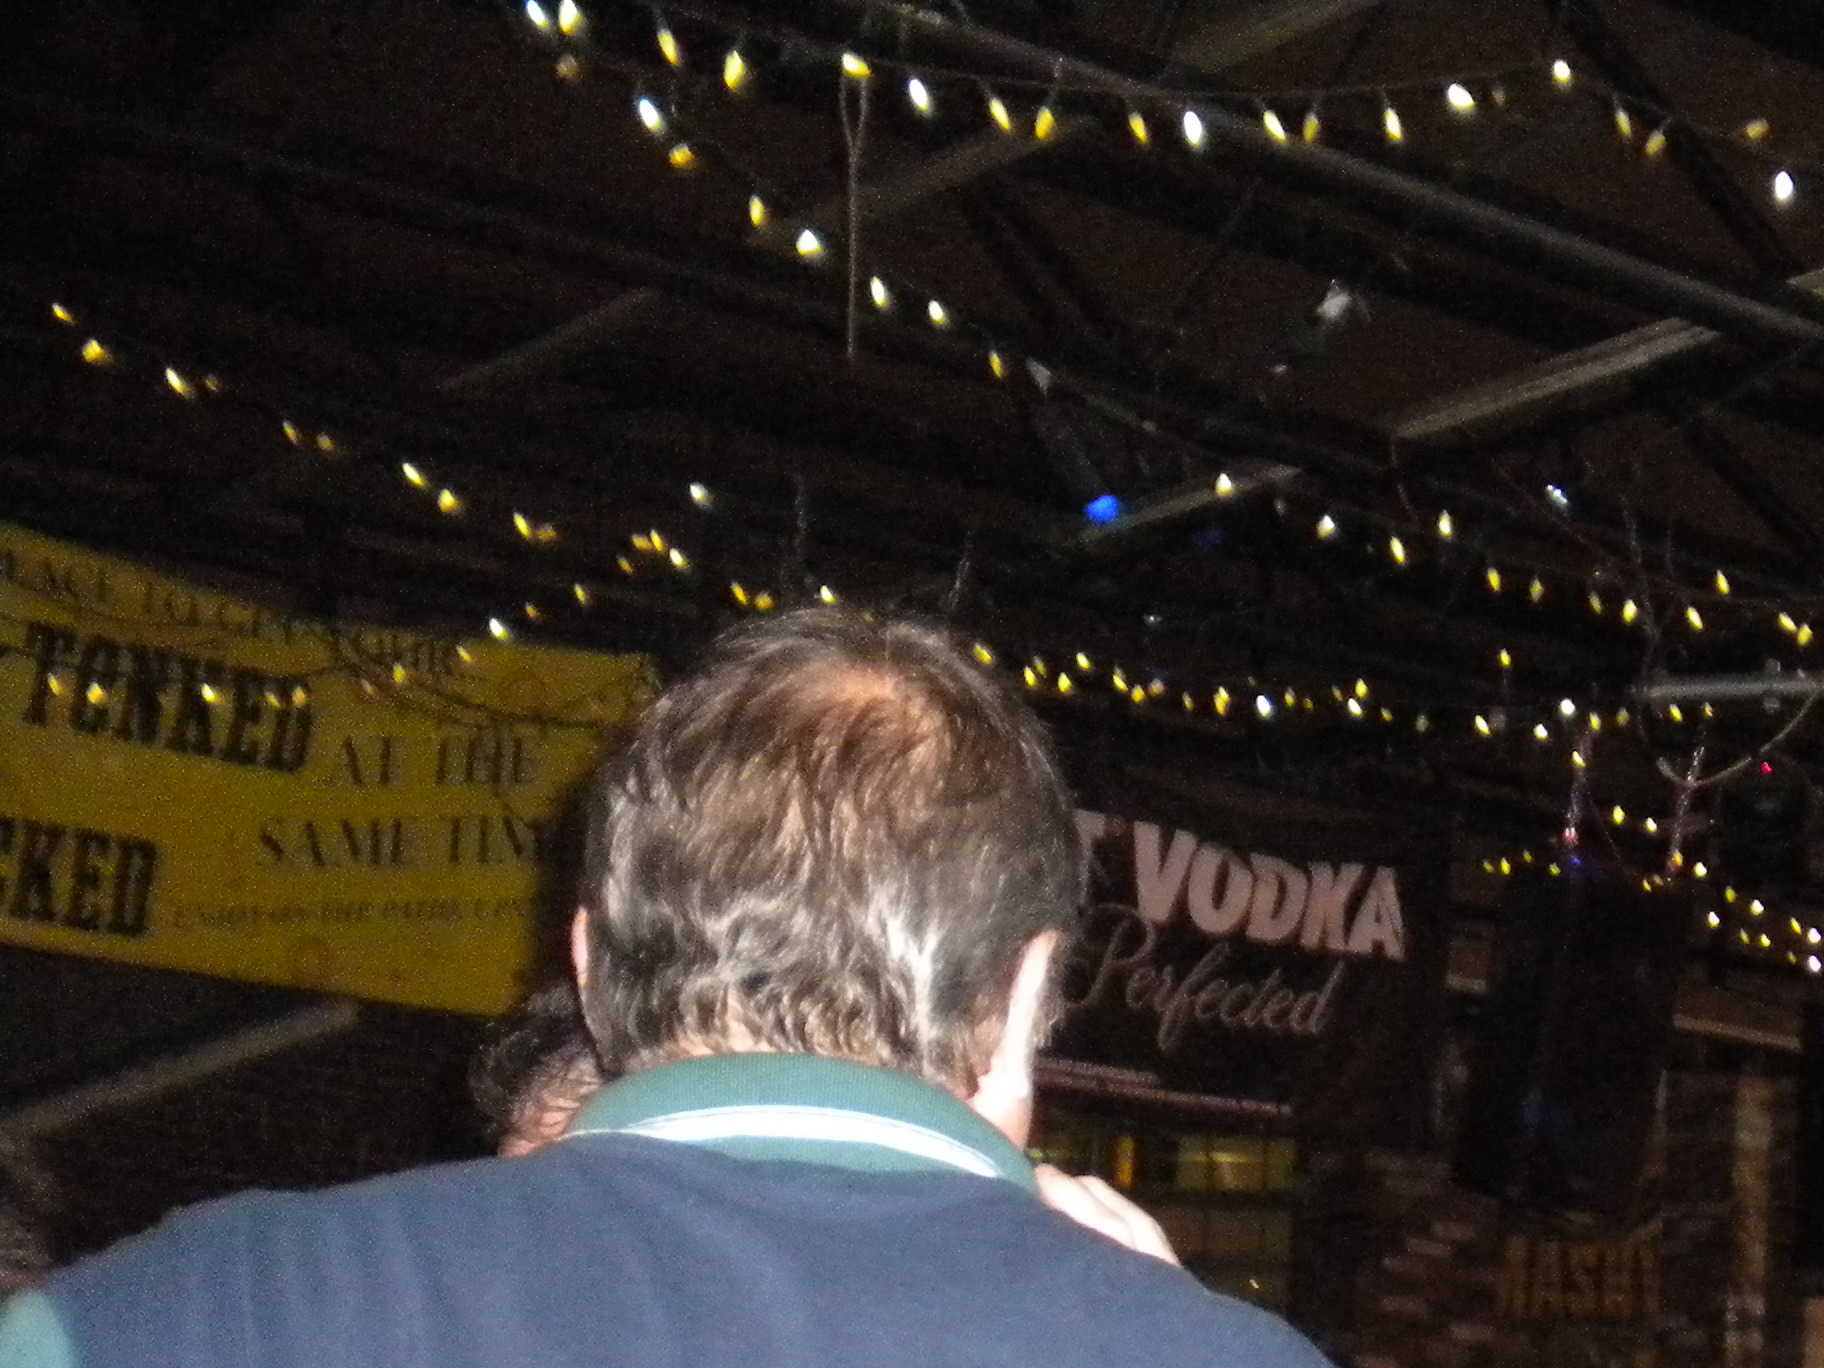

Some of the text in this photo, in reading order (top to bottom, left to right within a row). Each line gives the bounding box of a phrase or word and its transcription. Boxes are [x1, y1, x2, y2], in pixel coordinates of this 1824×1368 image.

[22, 620, 315, 775] TONKED
[324, 735, 534, 787] AT THE
[257, 814, 546, 869] SAME TIM
[1133, 820, 1407, 963] VODKA
[1066, 902, 1347, 1052] Perfected
